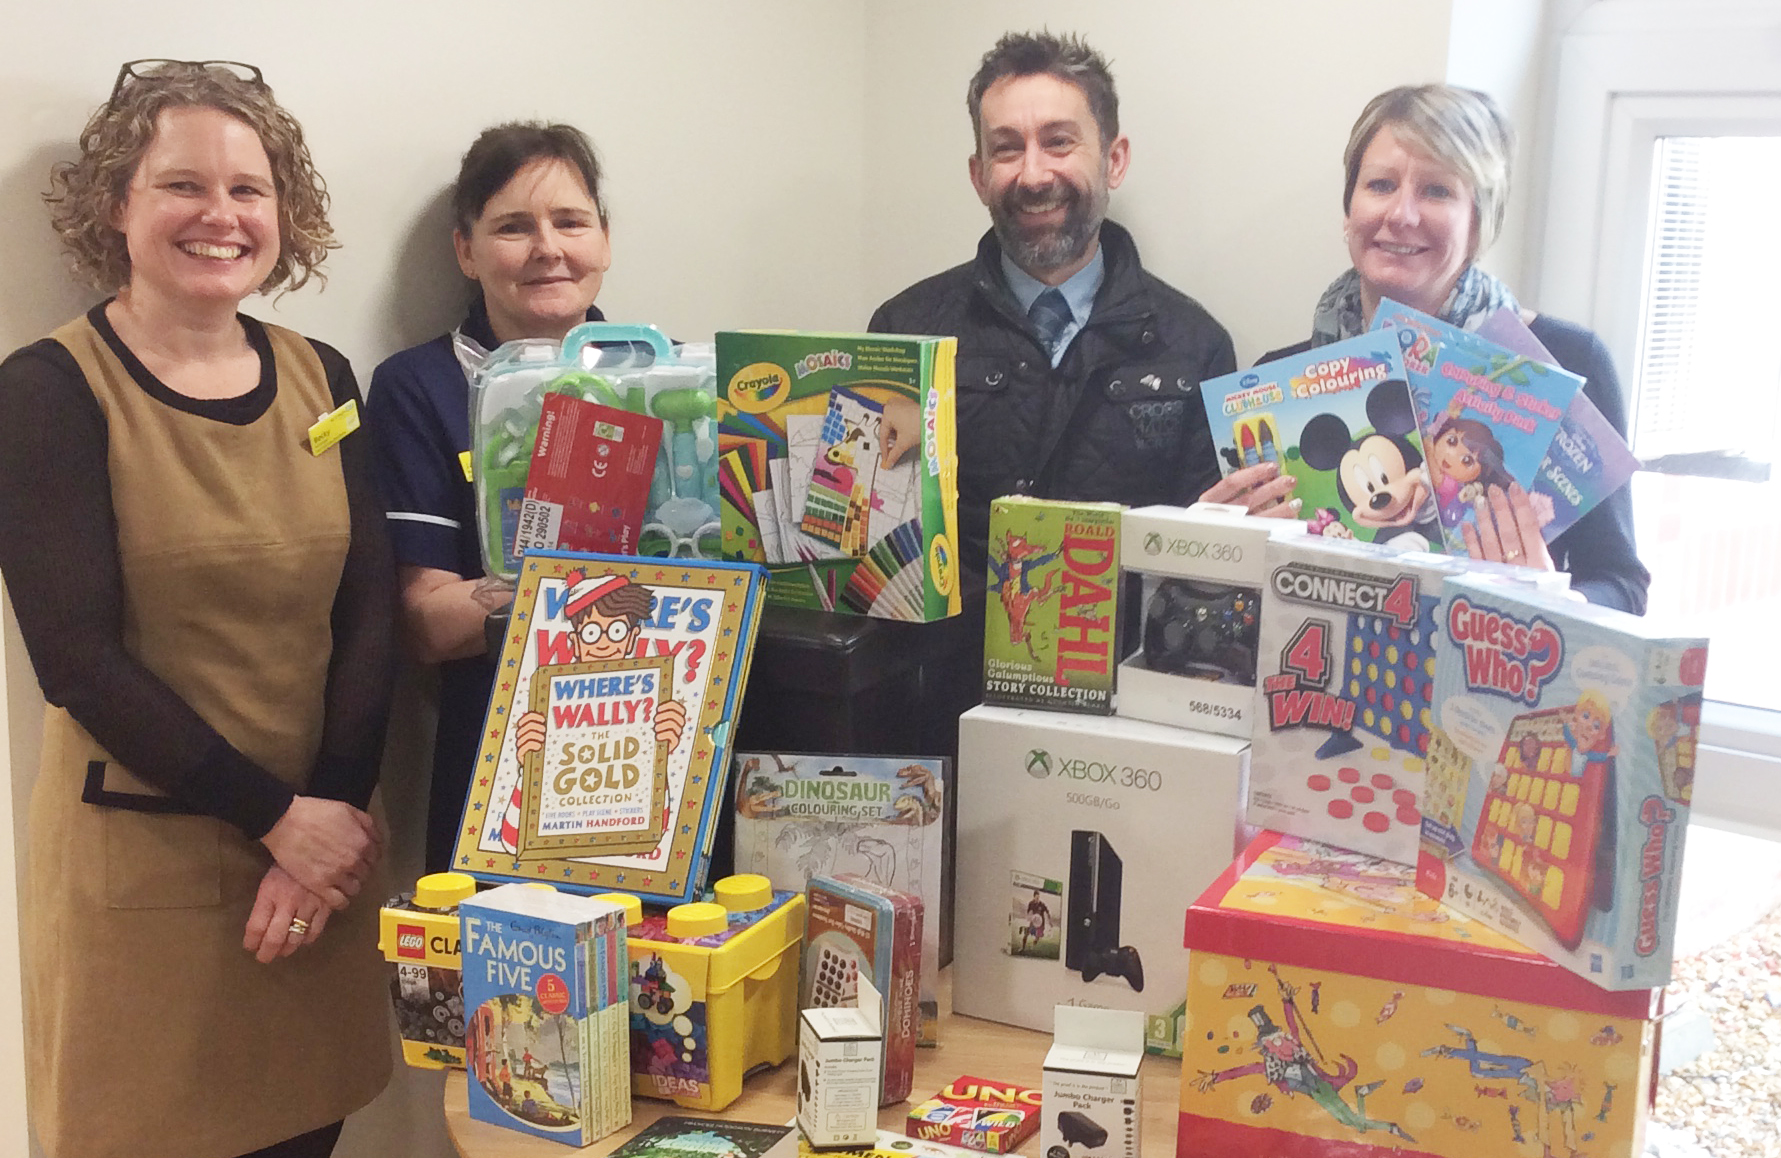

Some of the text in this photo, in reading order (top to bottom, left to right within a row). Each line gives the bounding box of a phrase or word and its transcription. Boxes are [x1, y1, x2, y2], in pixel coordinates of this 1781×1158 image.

[1305, 357, 1350, 378] Copy
[737, 373, 780, 392] Crayola
[1296, 363, 1387, 398] Colouring
[537, 410, 556, 458] Warning!
[535, 505, 551, 541] 290502
[1064, 523, 1116, 538] ROALD
[1167, 538, 1210, 560] XBOX
[1275, 570, 1415, 624] CONNECT 4
[1055, 534, 1116, 687] DAHL
[1451, 599, 1528, 658] Guess
[1288, 625, 1326, 680] 4
[1466, 626, 1561, 700] Who?
[987, 658, 1032, 672] Glorious
[554, 673, 655, 701] WHERE'S
[986, 680, 1107, 702] STORY COLLECTION
[552, 697, 654, 730] WALLY?
[1189, 700, 1242, 721] 568/5334
[1272, 690, 1356, 732] WIN!
[591, 730, 610, 740] THE
[558, 736, 640, 766] SOLID
[553, 763, 640, 796] GOLD
[1058, 757, 1162, 792] XBOX 360
[559, 793, 633, 808] COLLECTION
[783, 779, 891, 803] DINOSAUR
[790, 802, 884, 817] COLOURING SET
[542, 816, 645, 831] MARTIN HANDFORD
[1639, 796, 1676, 883] Who?
[1636, 882, 1664, 957] Guess
[400, 933, 424, 949] LEGO
[465, 916, 567, 973] THE FAMOUS
[400, 966, 427, 980] 4-99
[486, 959, 533, 992] FIVE
[547, 978, 556, 992] 5
[902, 969, 914, 1039] DOMINOES
[1154, 1018, 1167, 1039] 3
[651, 1074, 699, 1093] IDEAS
[943, 1084, 1042, 1106] UNO
[1054, 1091, 1115, 1104] Jumbo Charger
[1073, 1101, 1092, 1110] Pack
[918, 1124, 952, 1140] UNO
[981, 1119, 1016, 1128] WILD
